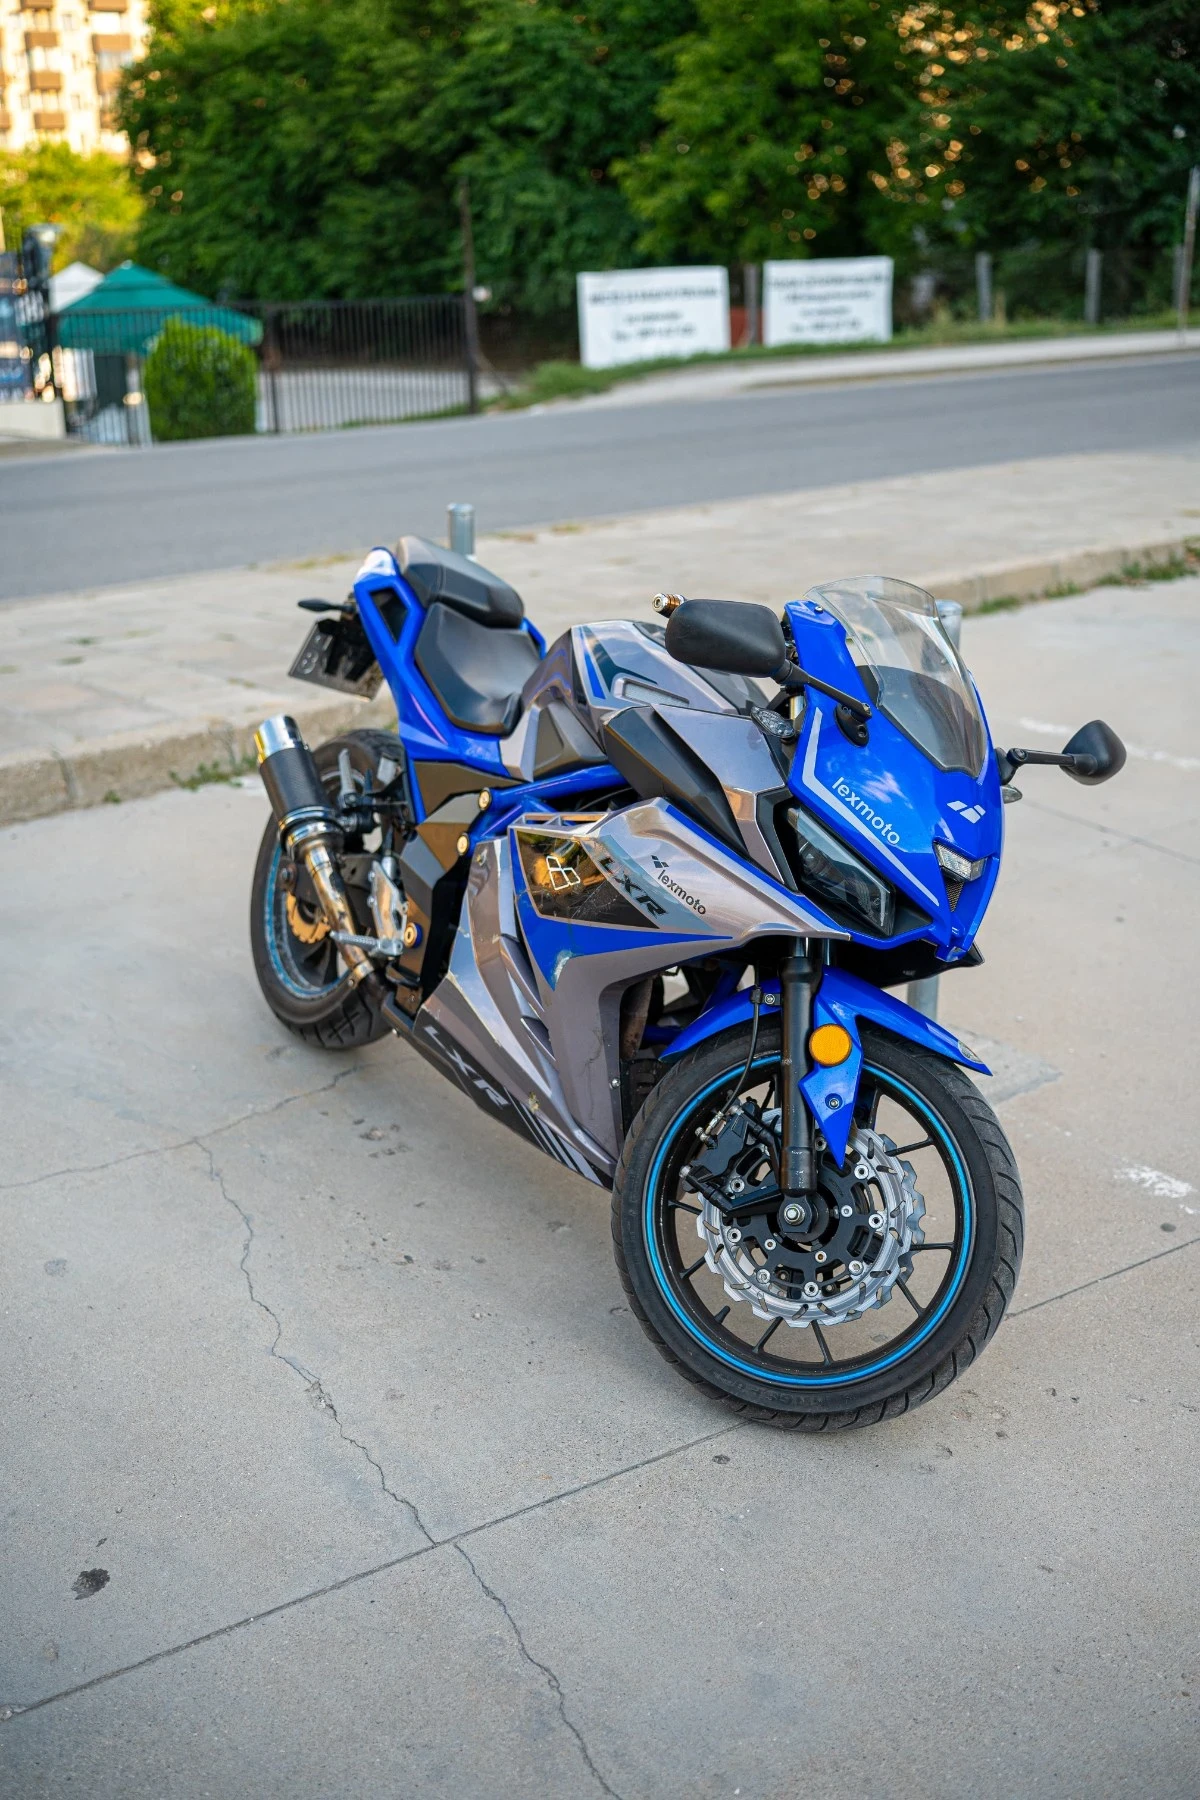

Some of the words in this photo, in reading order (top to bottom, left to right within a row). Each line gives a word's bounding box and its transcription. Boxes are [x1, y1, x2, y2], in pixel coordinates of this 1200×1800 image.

[831, 776, 901, 846] lexmoto
[598, 856, 669, 919] LXR
[657, 869, 707, 916] lexmoto
